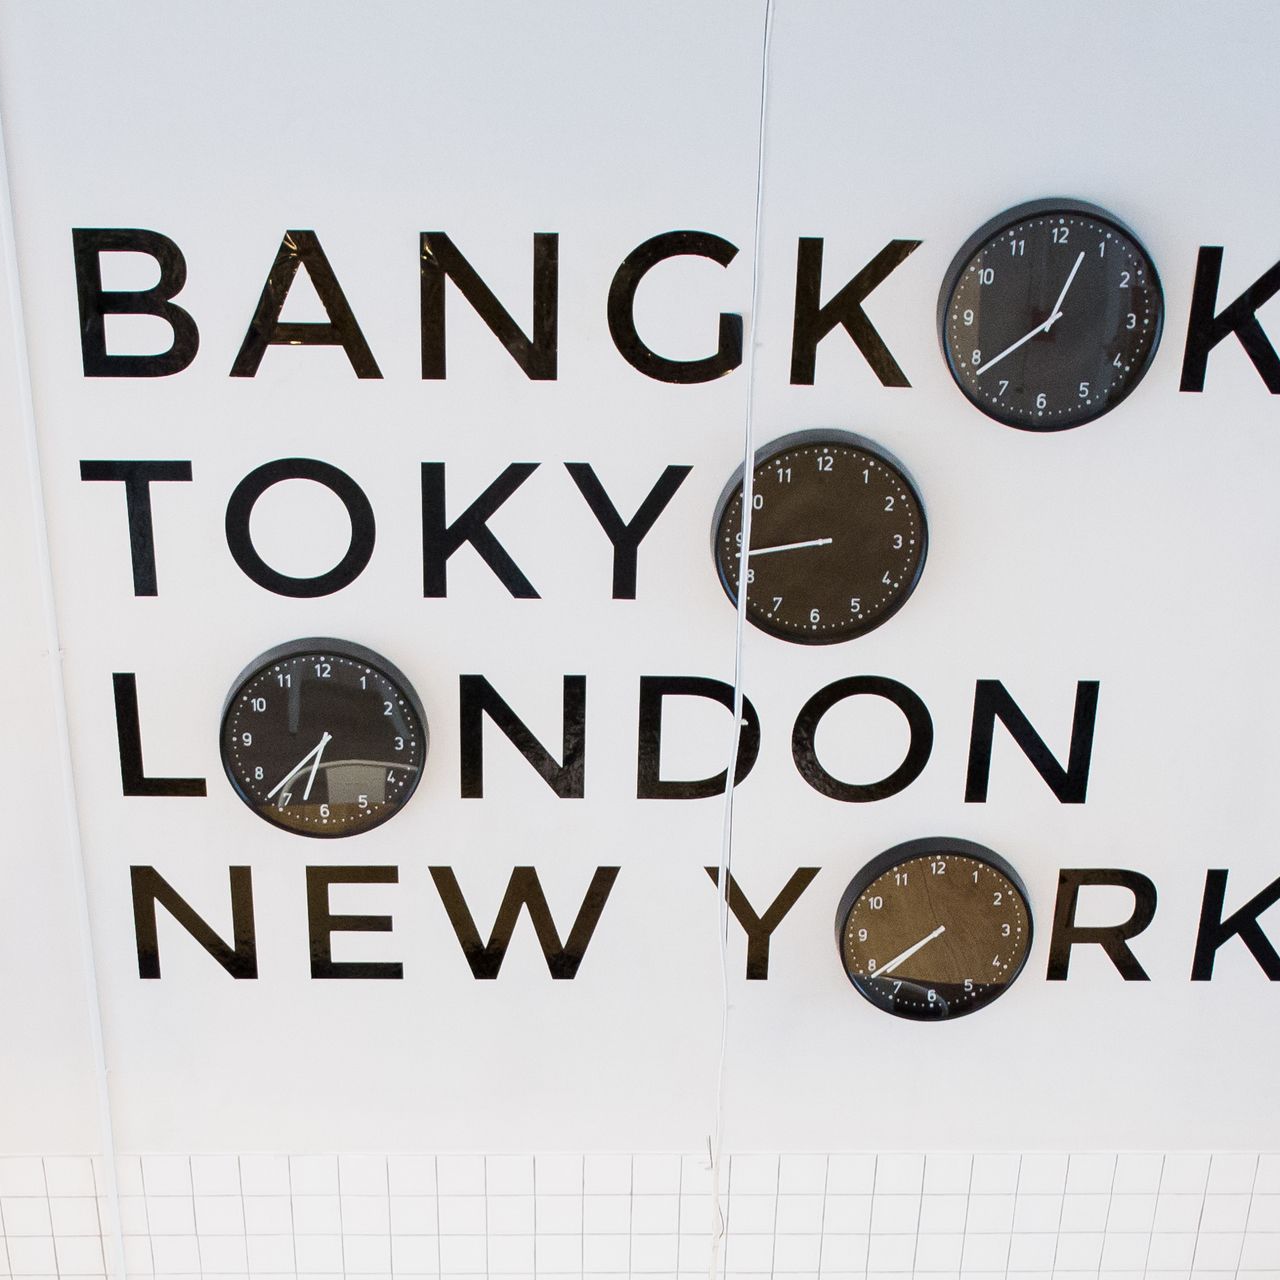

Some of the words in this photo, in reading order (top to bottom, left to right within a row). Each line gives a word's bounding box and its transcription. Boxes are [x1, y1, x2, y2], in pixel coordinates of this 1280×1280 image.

[1052, 227, 1070, 244] 12
[1010, 240, 1025, 257] 11
[1098, 242, 1106, 258] 1
[978, 268, 995, 285] 10
[1119, 272, 1129, 288] 2
[964, 310, 974, 326] 9
[1126, 314, 1137, 330] 3
[972, 351, 982, 364] 8
[1113, 353, 1122, 368] 4
[998, 381, 1009, 397] 7
[1079, 382, 1089, 398] 5
[1036, 394, 1047, 410] 6
[817, 457, 833, 472] 12
[777, 468, 792, 483] 11
[863, 469, 869, 484] 1
[885, 497, 894, 512] 2
[893, 535, 903, 550] 3
[747, 569, 755, 583] 8
[882, 571, 891, 585] 4
[773, 597, 783, 612] 7
[851, 598, 861, 613] 5
[810, 609, 820, 623] 6
[315, 664, 331, 678] 12
[278, 674, 292, 688] 11
[360, 676, 367, 690] 1
[251, 697, 267, 712] 10
[384, 701, 393, 716] 2
[242, 732, 252, 747] 9
[395, 737, 404, 750] 3
[255, 766, 264, 780] 8
[387, 770, 396, 783] 4
[283, 793, 292, 806] 7
[358, 795, 368, 808] 5
[320, 804, 330, 817] 6
[931, 862, 946, 875] 12
[895, 873, 908, 886] 11
[973, 871, 979, 883] 1
[869, 896, 883, 910] 10
[994, 892, 1002, 906] 2
[130, 866, 620, 981] NEW
[1001, 924, 1011, 937] 3
[858, 929, 868, 941] 9
[868, 959, 877, 971] 8
[993, 955, 1001, 966] 4
[893, 981, 902, 993] 7
[964, 979, 973, 992] 5
[927, 990, 937, 1002] 6
